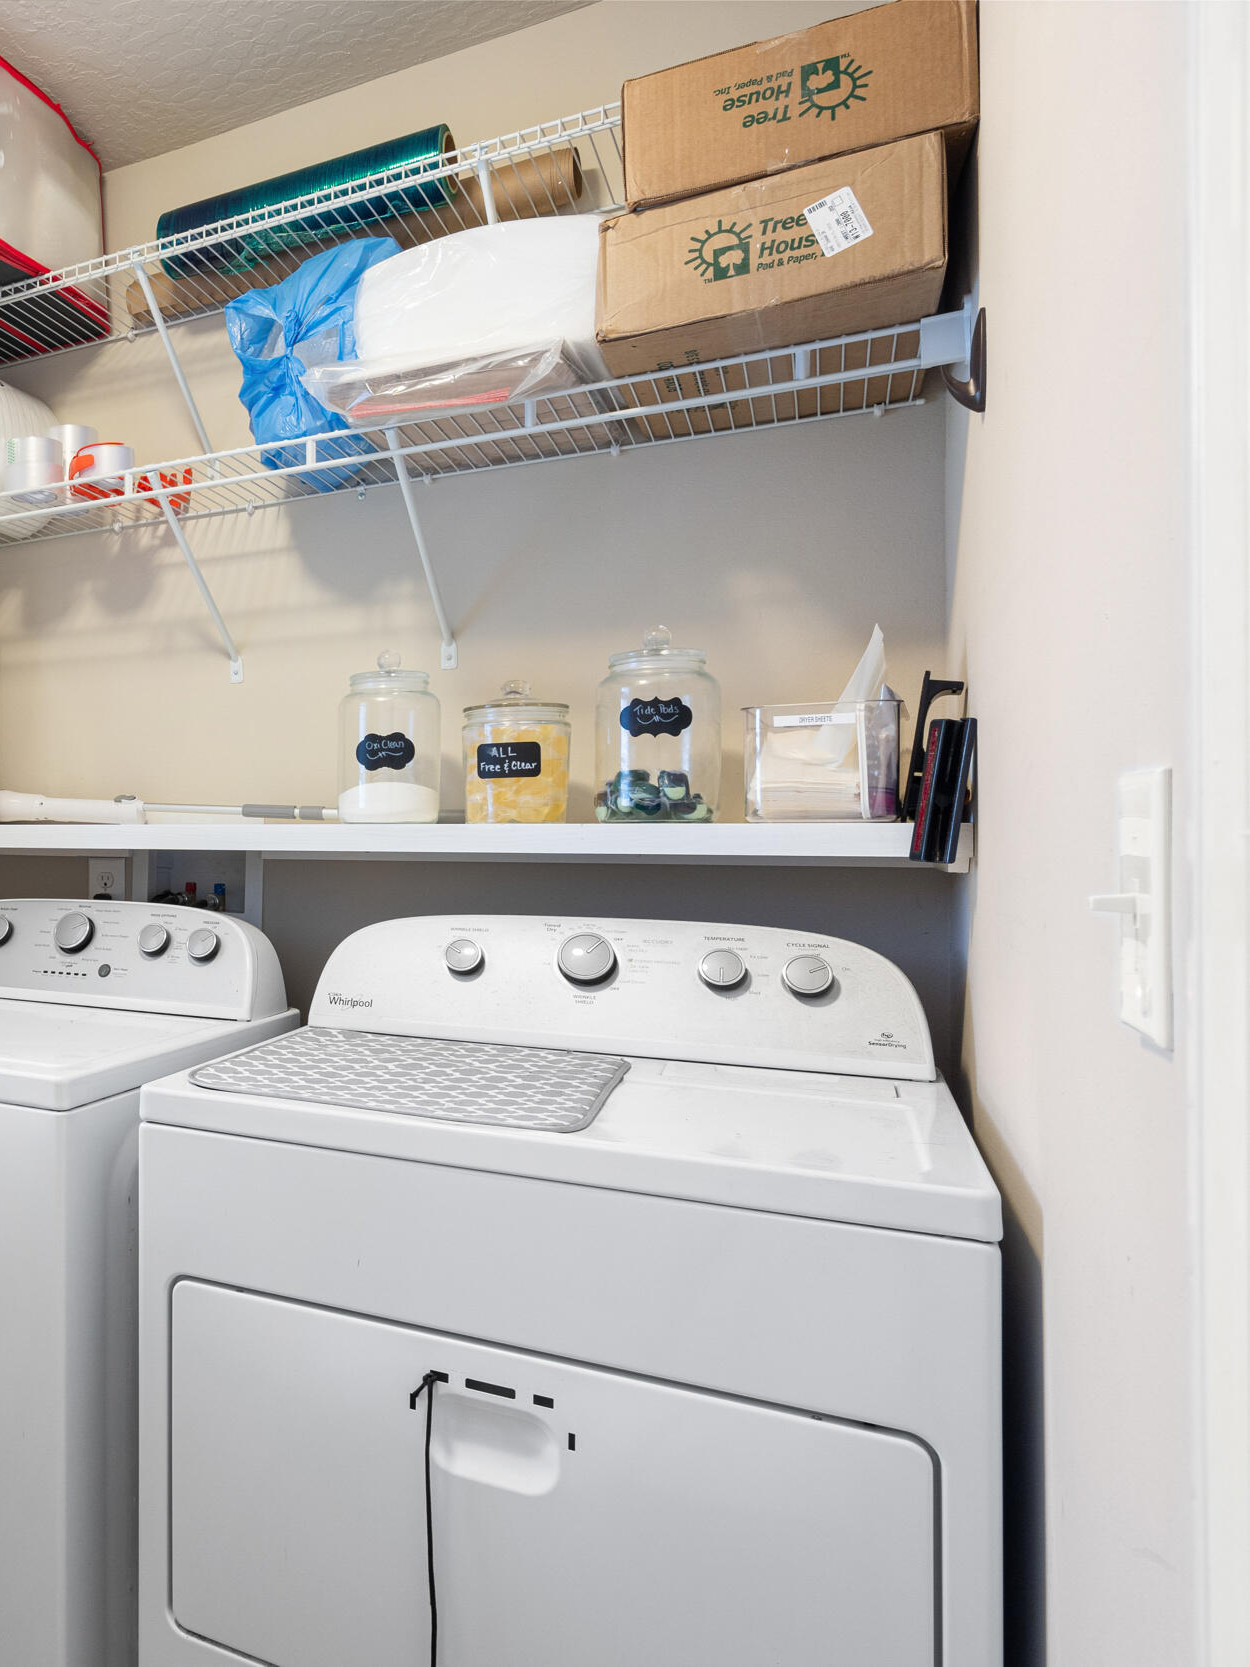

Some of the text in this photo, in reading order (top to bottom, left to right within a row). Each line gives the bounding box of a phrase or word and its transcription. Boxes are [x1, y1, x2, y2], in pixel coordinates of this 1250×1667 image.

[713, 68, 795, 96] Pad & Paper, Inc.
[722, 81, 793, 112] House
[742, 104, 792, 129] Tree
[759, 212, 808, 237] Tree
[758, 233, 823, 259] Hous
[756, 259, 775, 273] Pad
[776, 257, 786, 268] &
[787, 251, 817, 266] Paper,
[633, 703, 680, 716] Tide Pods
[365, 739, 405, 750] Oxi Clean
[490, 746, 518, 758] ALL
[480, 761, 501, 772] Free
[511, 760, 538, 770] Clear
[703, 935, 746, 943] TEMPERATURE
[328, 995, 374, 1009] Whirlpool
